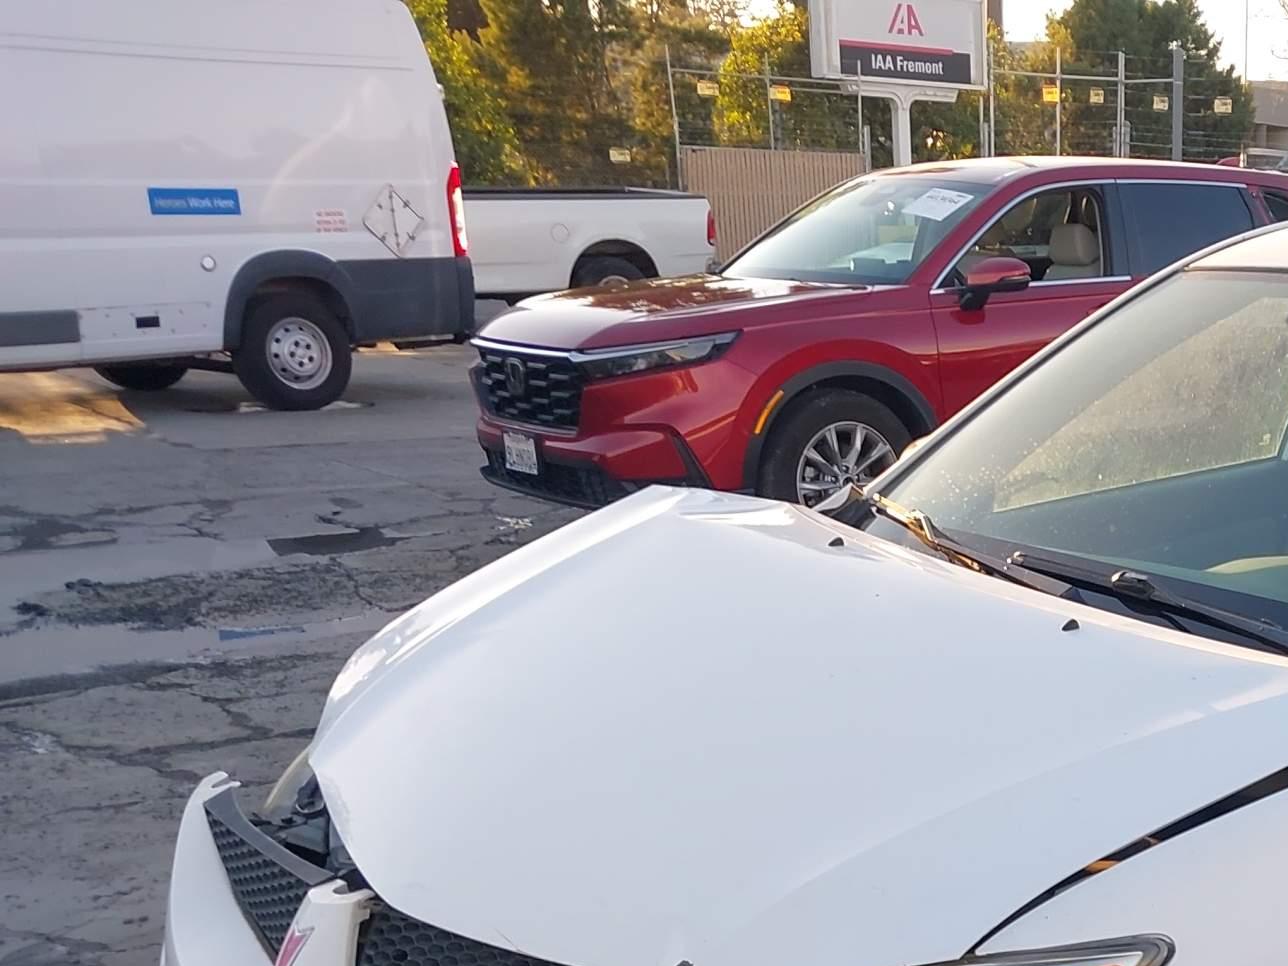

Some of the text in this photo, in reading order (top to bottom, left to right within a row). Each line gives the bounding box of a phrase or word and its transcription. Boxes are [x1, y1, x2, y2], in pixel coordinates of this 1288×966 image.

[871, 53, 944, 75] IAA Fremont
[187, 197, 213, 208] Work
